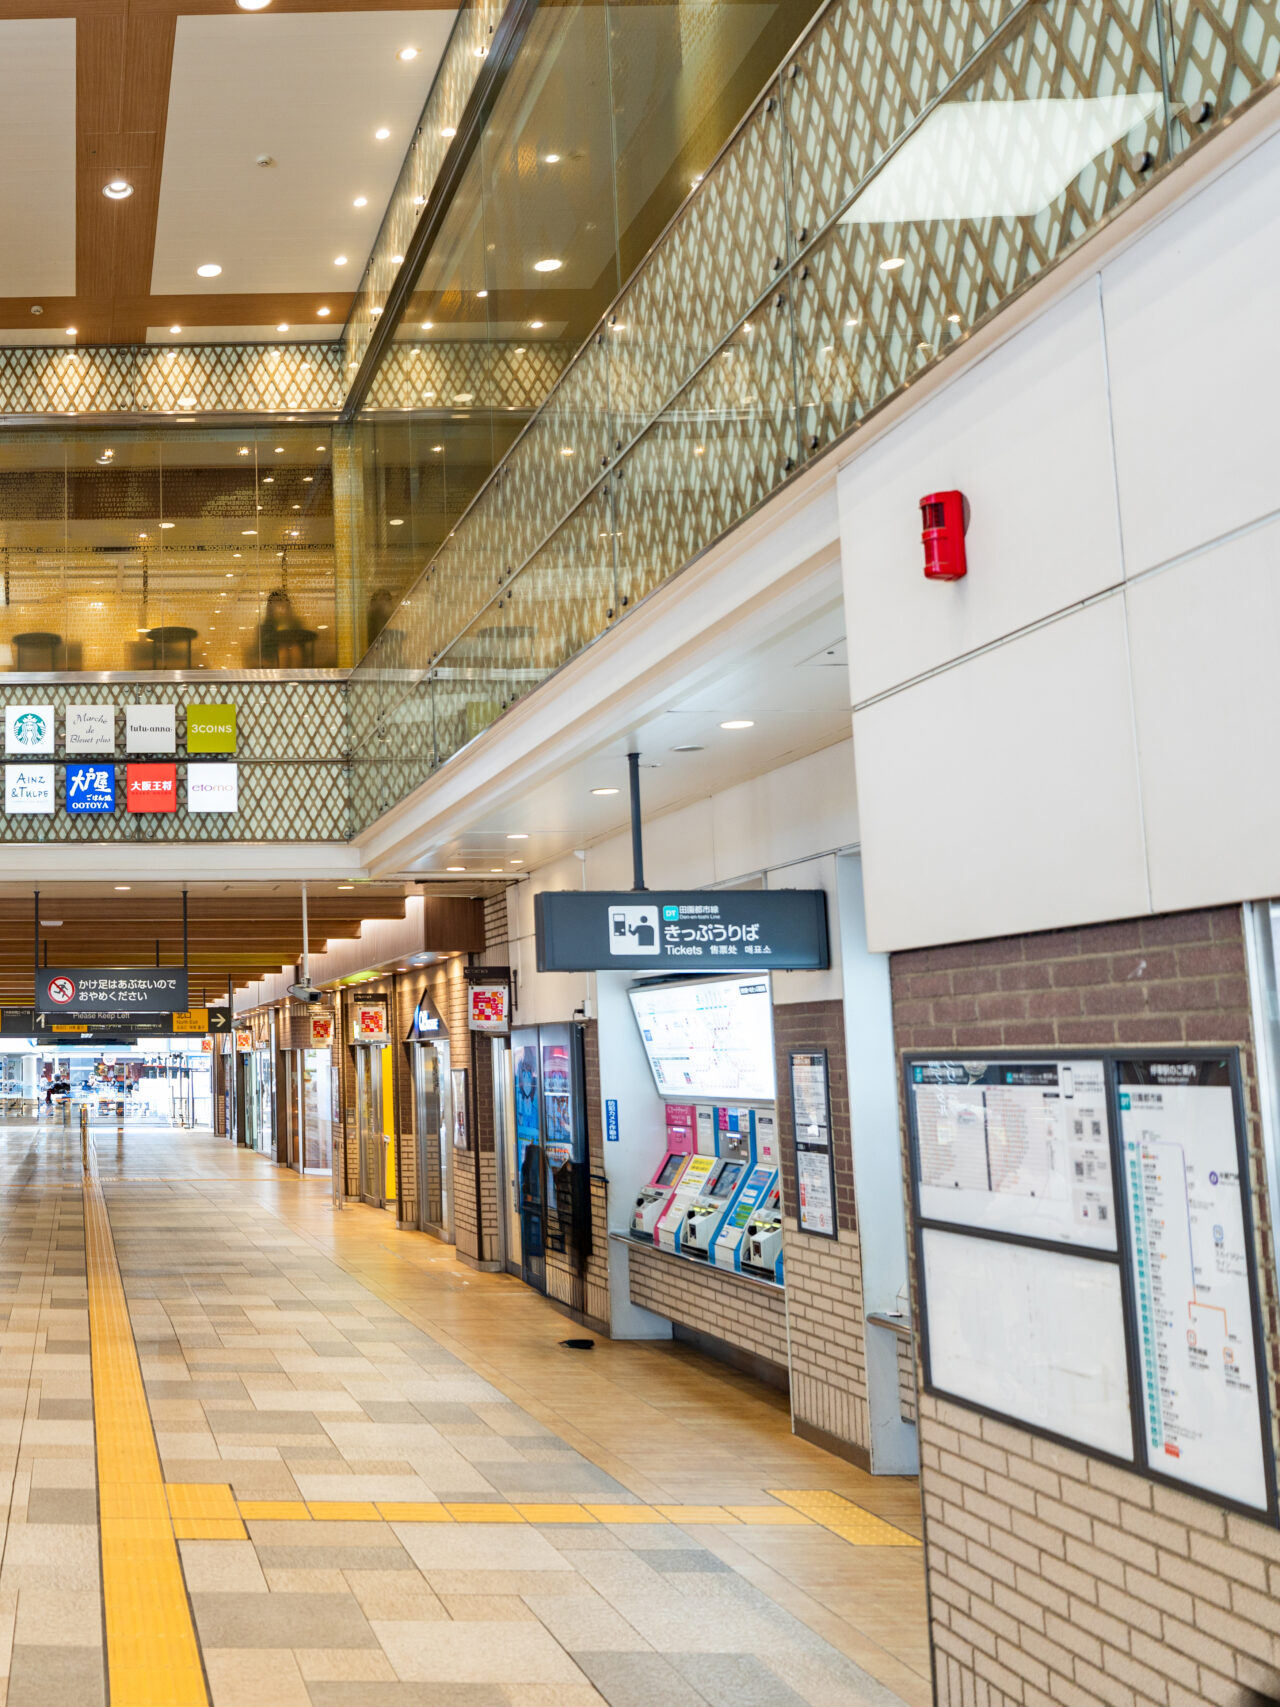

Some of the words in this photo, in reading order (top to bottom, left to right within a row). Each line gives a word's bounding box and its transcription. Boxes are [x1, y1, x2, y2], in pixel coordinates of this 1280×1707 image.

[191, 724, 232, 734] 3COINS
[70, 768, 111, 797] 大戸屋
[130, 781, 172, 792] 大阪王将
[192, 784, 234, 792] etomo
[72, 802, 109, 810] OOTOYA
[680, 906, 720, 914] 田園都市線
[664, 923, 760, 942] きっぷうりば
[665, 945, 703, 955] Tickets
[78, 979, 177, 990] かけ足はあぶないので
[78, 991, 148, 1002] おやめください
